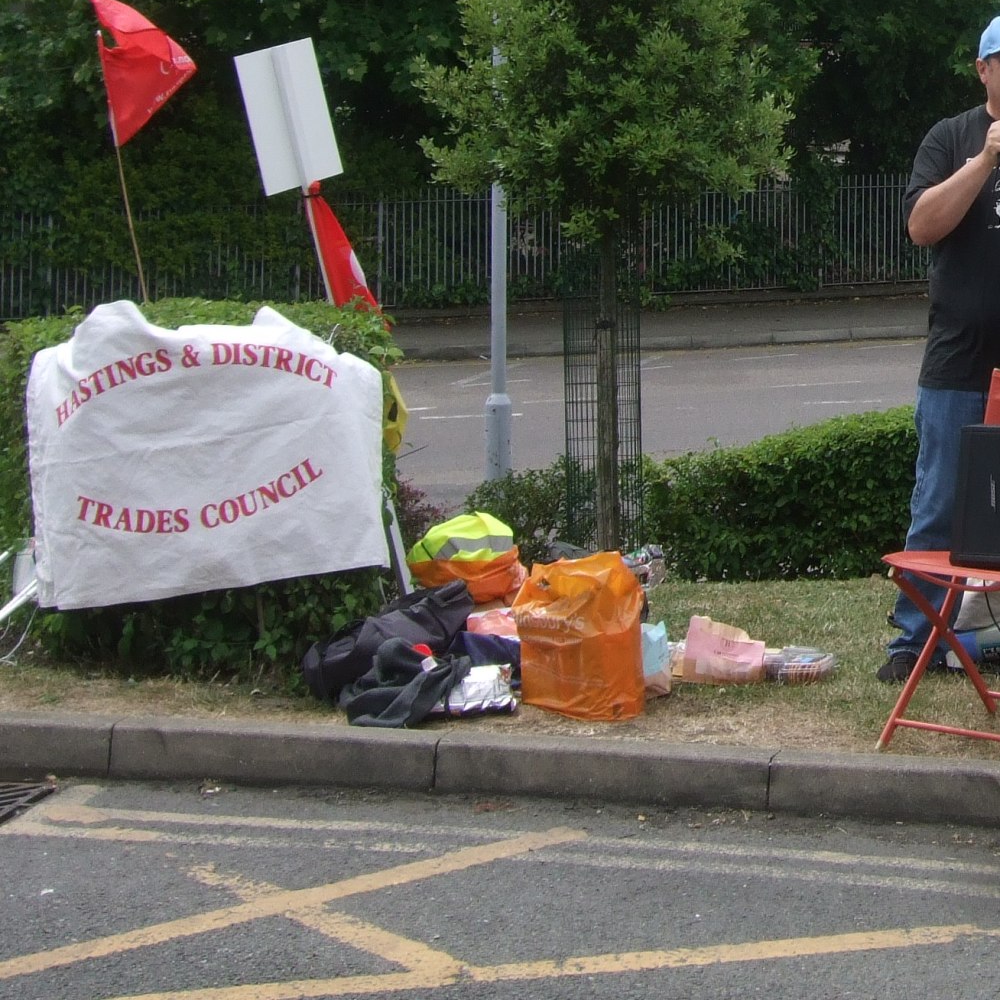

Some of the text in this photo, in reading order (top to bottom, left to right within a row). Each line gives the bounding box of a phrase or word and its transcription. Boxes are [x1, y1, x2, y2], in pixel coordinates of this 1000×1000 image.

[56, 343, 338, 427] HASTINGS & DISTRICT
[77, 458, 323, 533] TRADES COUNCIL
